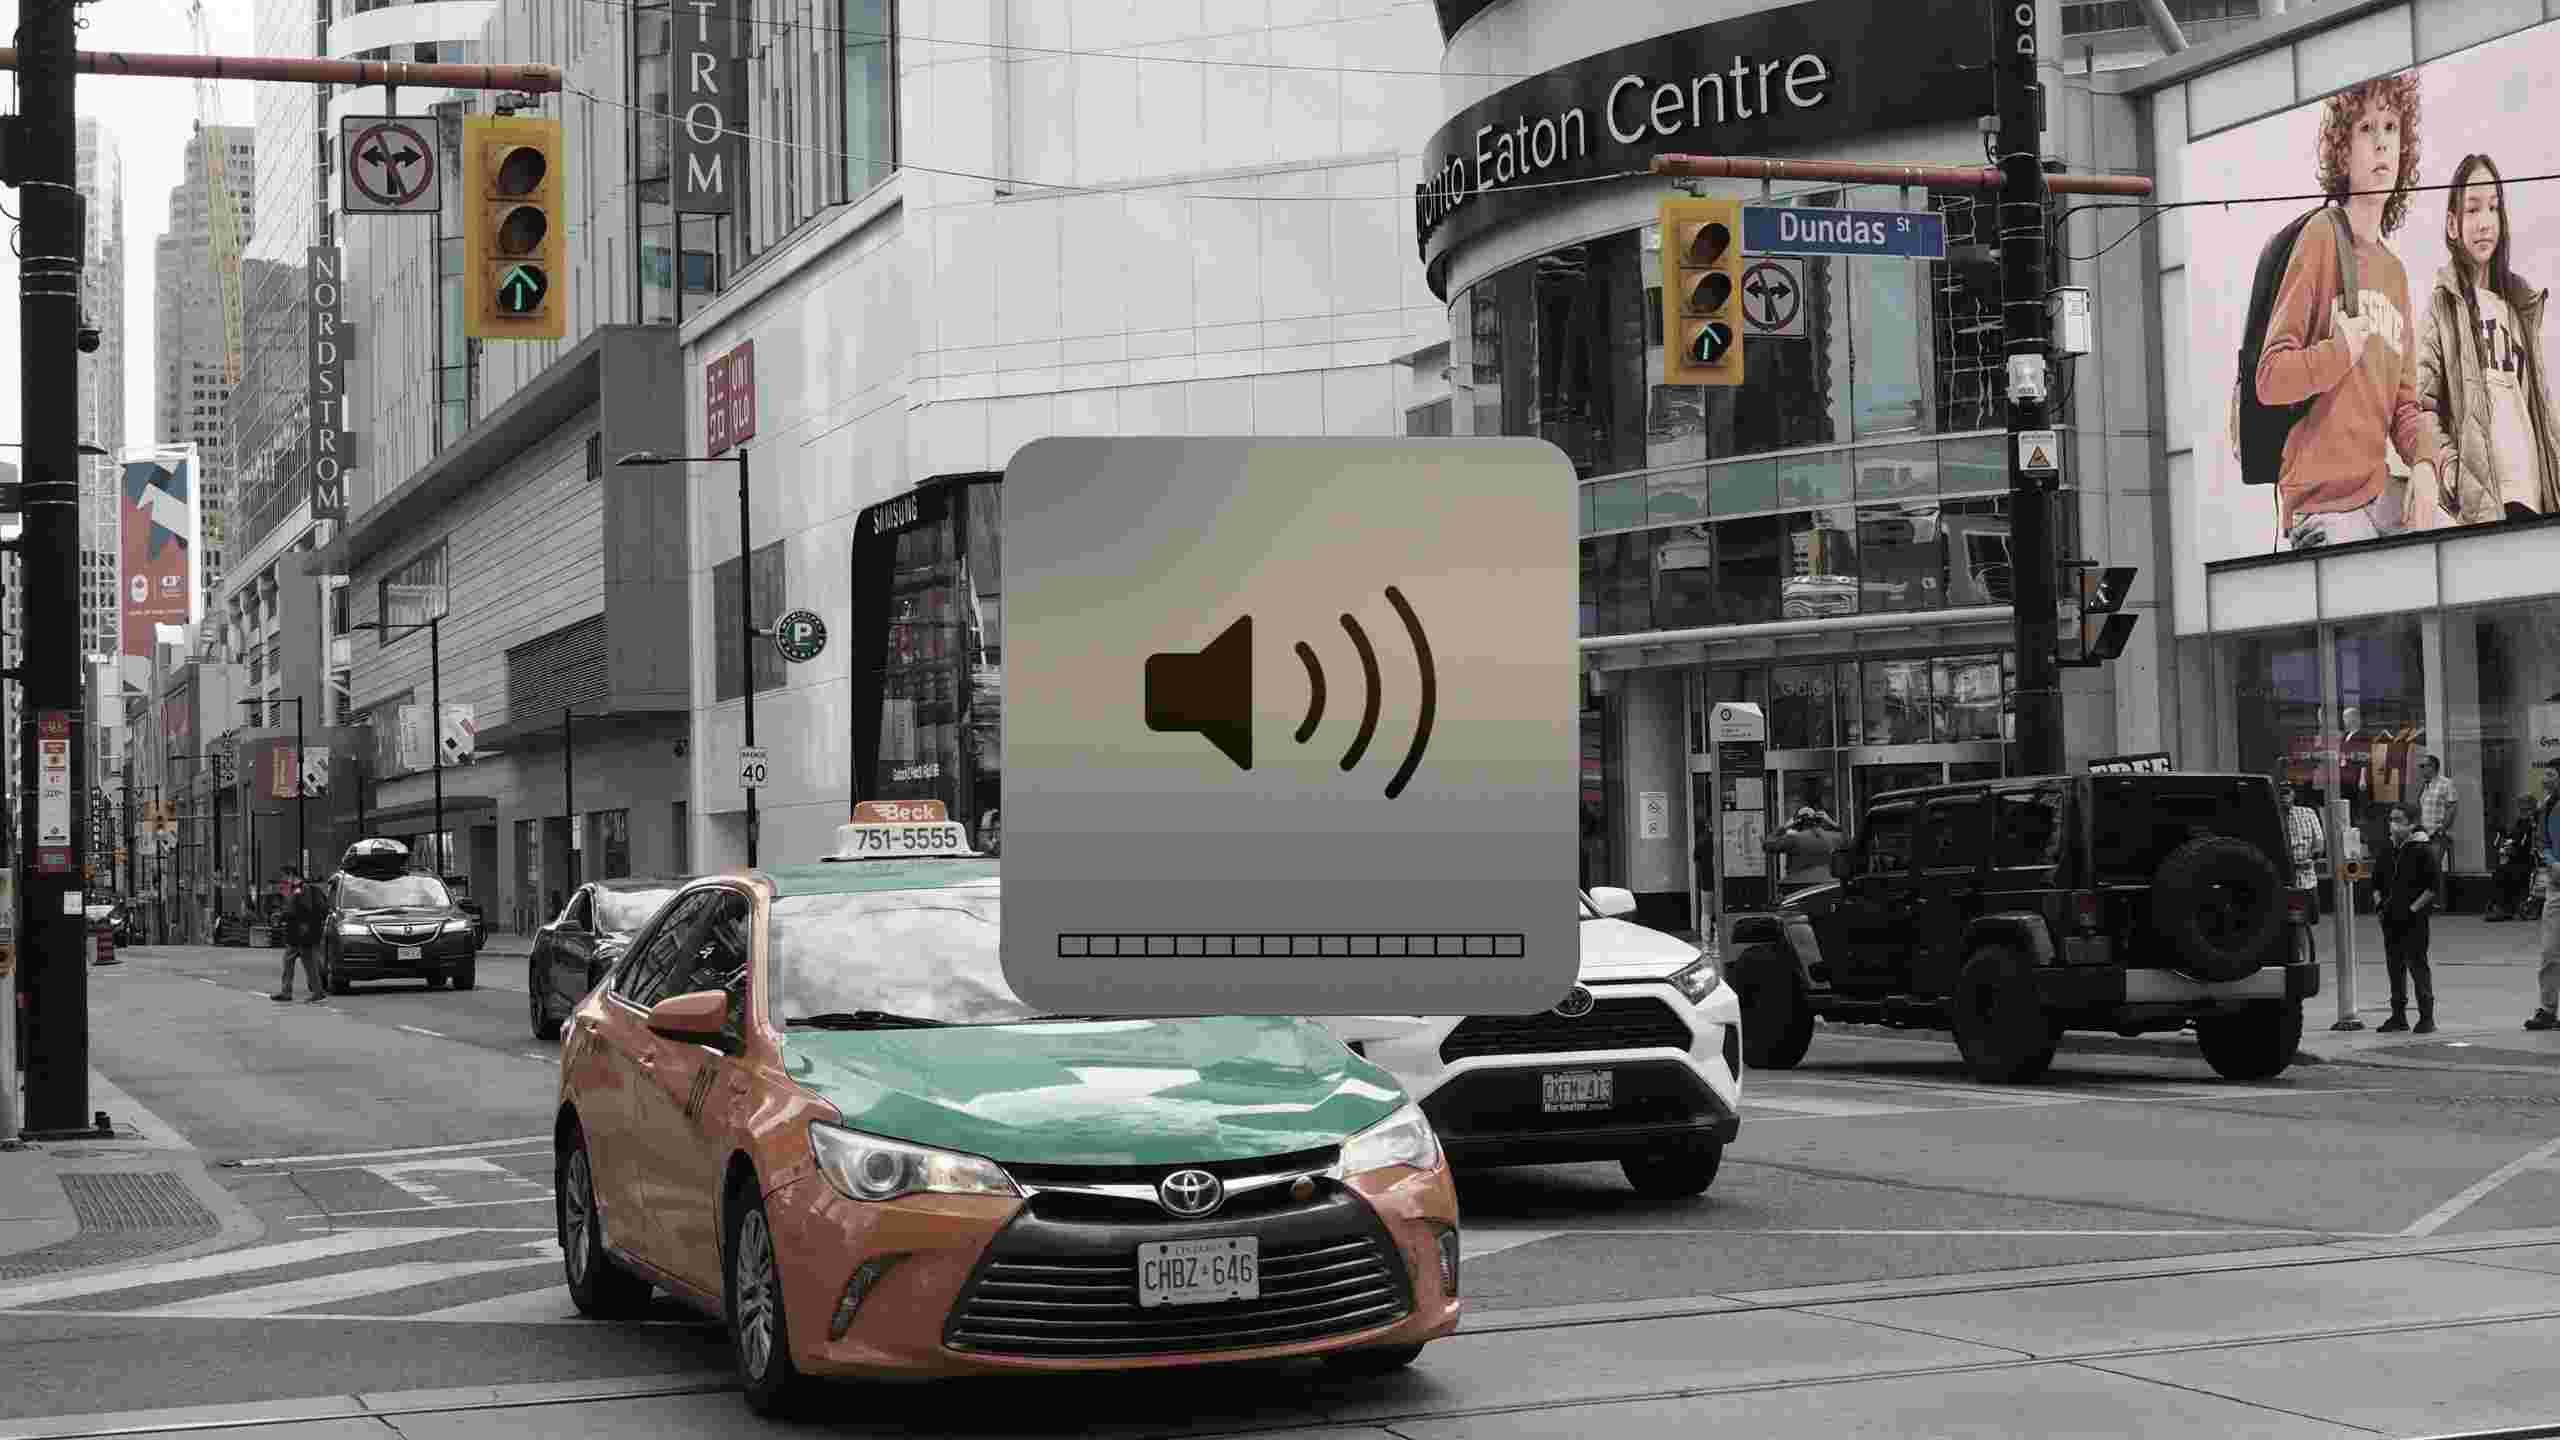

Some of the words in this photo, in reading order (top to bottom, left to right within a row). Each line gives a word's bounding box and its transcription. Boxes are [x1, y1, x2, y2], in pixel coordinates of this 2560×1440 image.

[1475, 107, 1586, 192] Eaton
[1606, 52, 1828, 144] Centre
[1779, 211, 1886, 245] Dundas
[1896, 215, 1911, 233] St
[313, 255, 339, 509] NORDSTROM
[873, 494, 919, 536] SAMSUNG
[742, 763, 766, 783] 40
[879, 803, 936, 821] Beck
[856, 827, 959, 851] 751-5555
